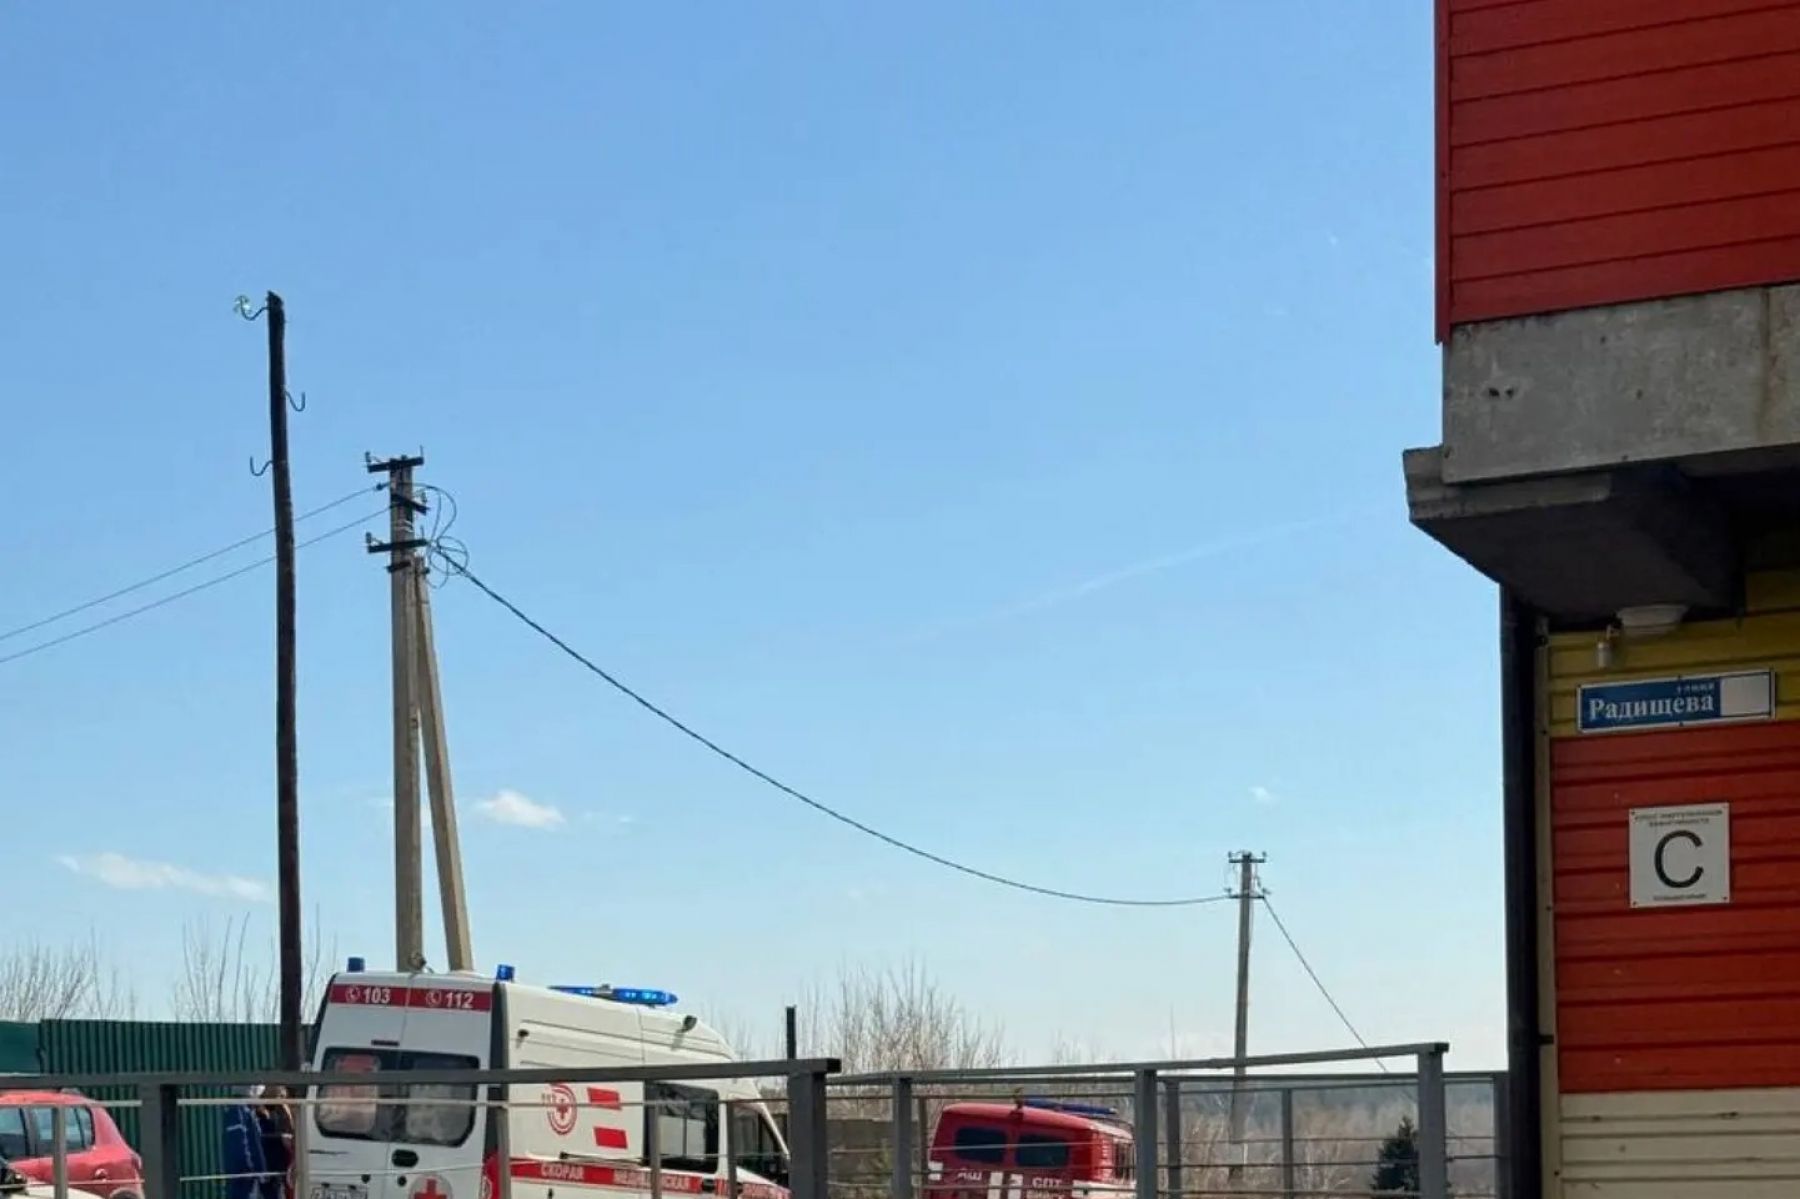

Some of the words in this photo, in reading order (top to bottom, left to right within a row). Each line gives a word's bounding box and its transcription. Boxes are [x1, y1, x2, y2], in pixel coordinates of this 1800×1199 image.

[1589, 695, 1714, 721] Радищева
[362, 987, 391, 1005] 103
[444, 992, 474, 1009] 112
[540, 1163, 585, 1181] СКОРАЯ
